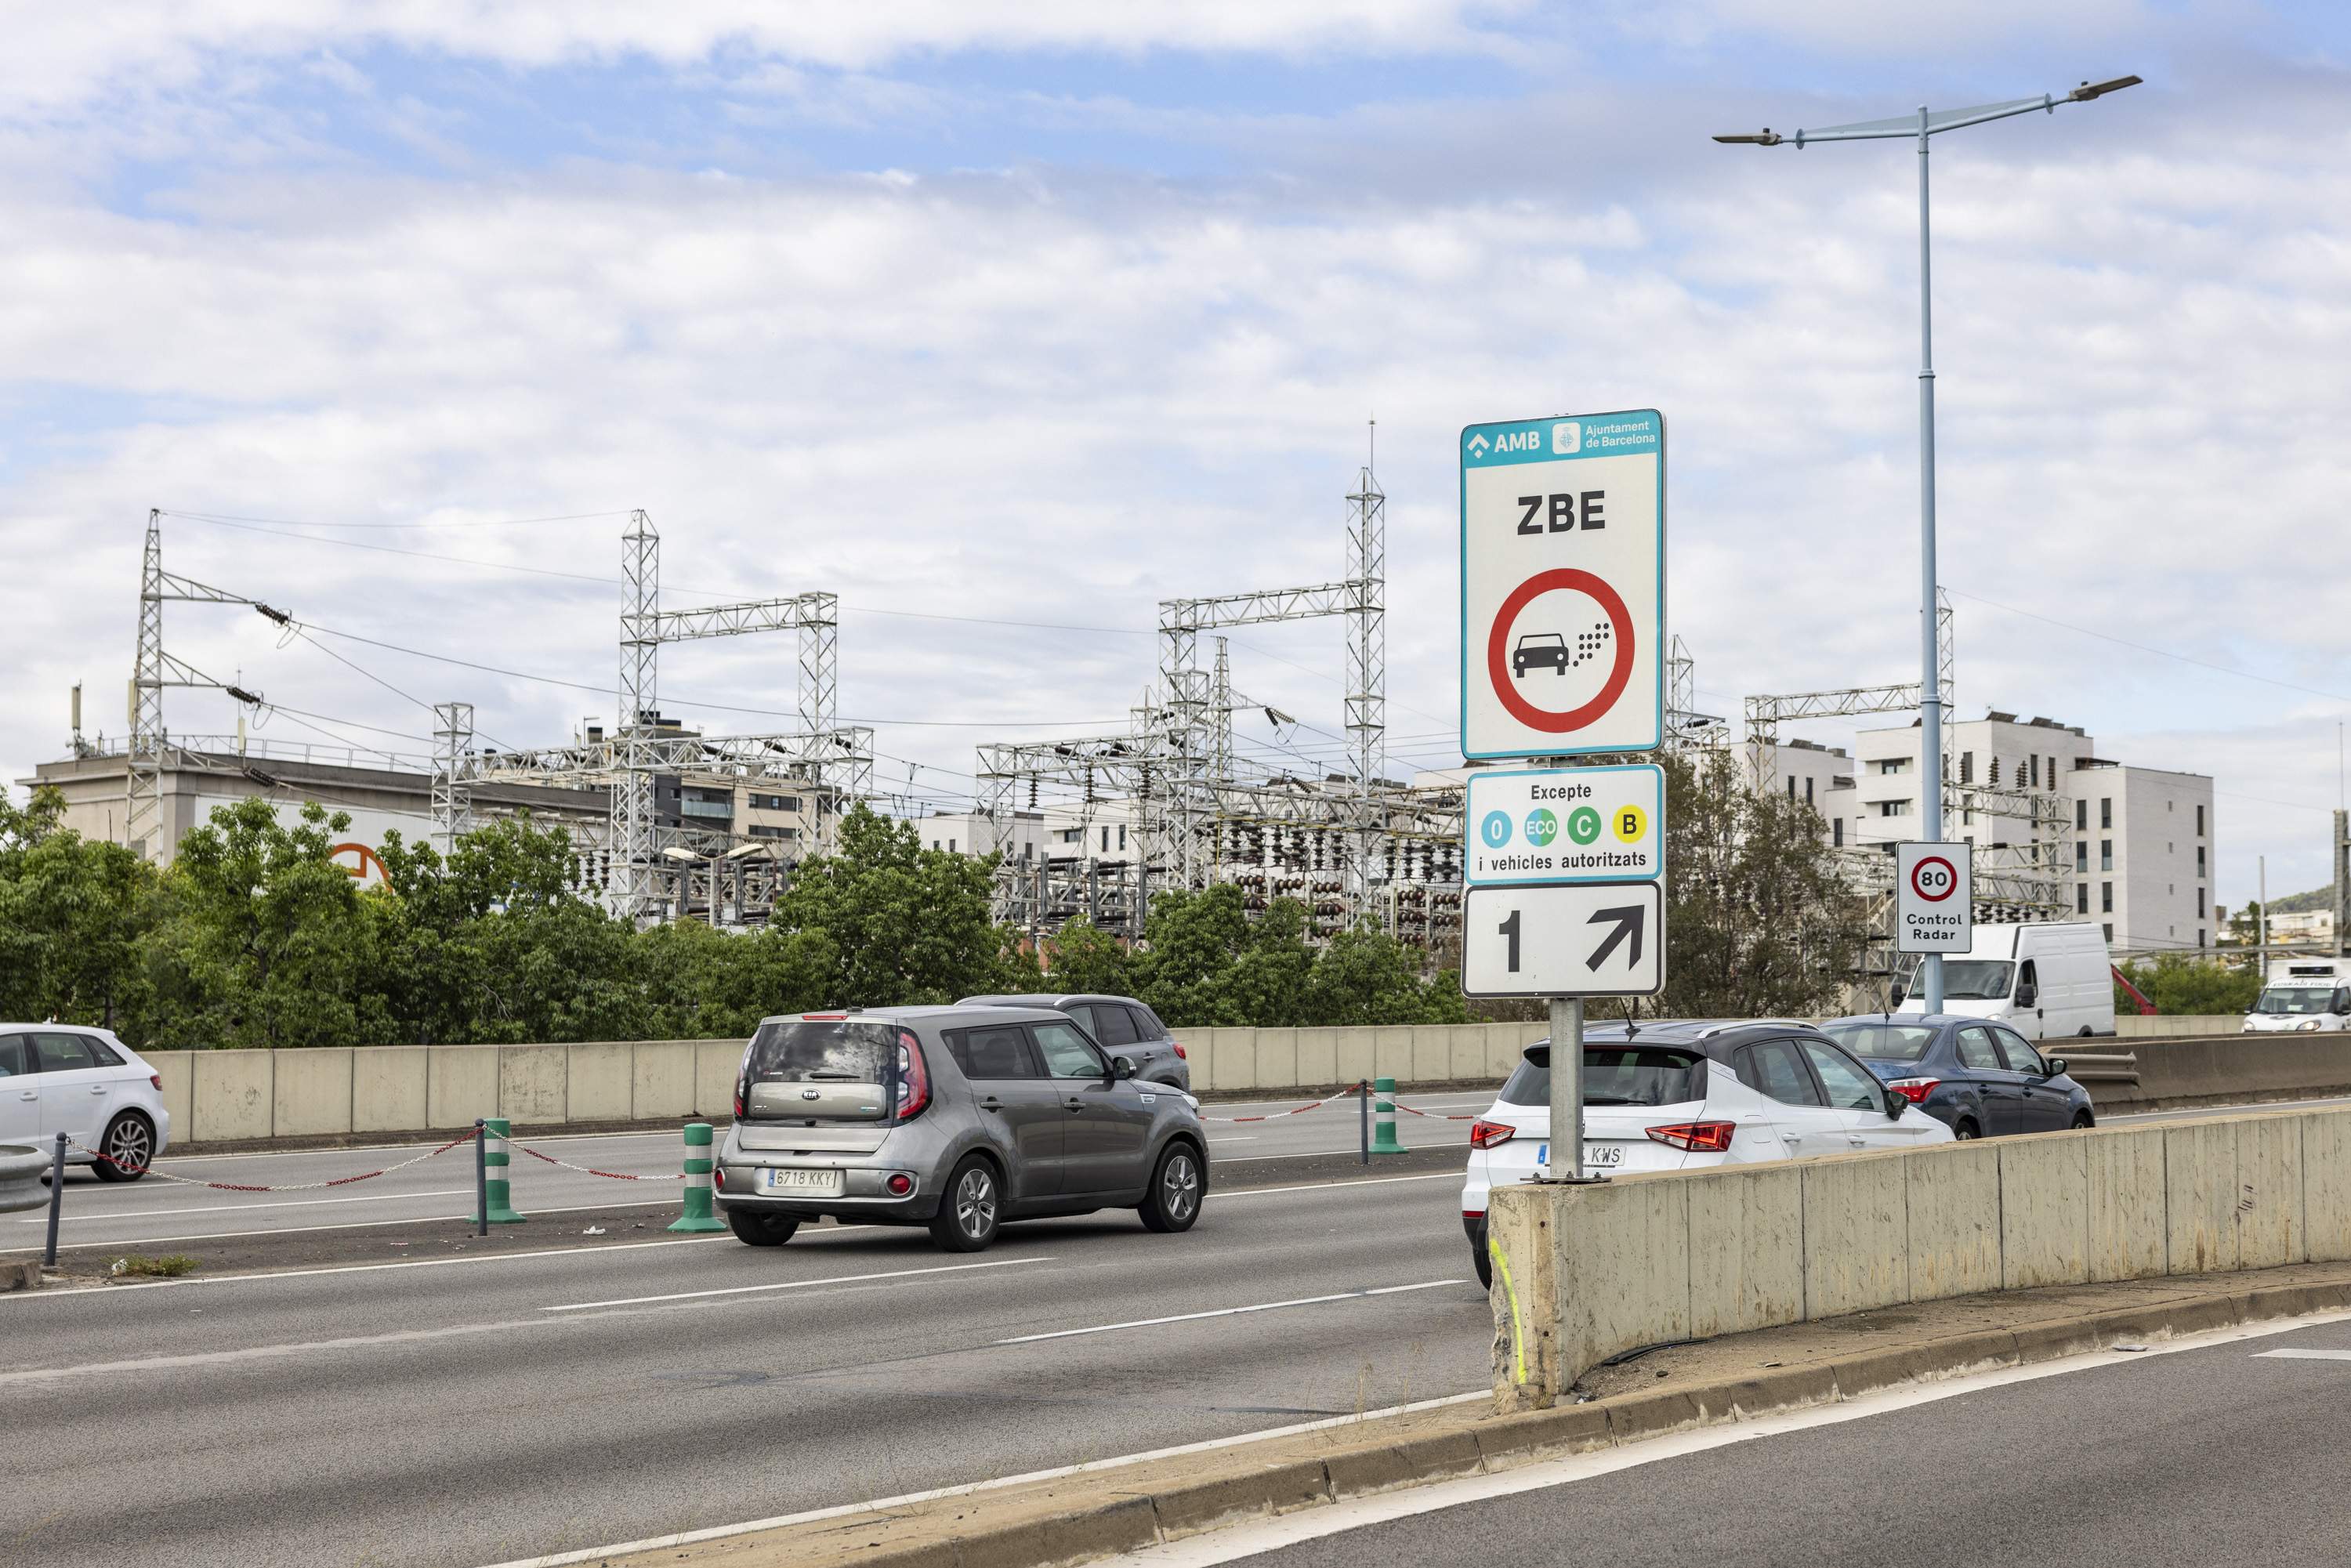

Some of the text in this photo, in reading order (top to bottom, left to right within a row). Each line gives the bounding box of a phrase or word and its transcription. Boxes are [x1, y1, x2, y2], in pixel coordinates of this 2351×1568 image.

[1585, 421, 1650, 438] Ajuntament
[1494, 431, 1541, 452] AMB
[1585, 434, 1656, 448] de Barcelona
[1517, 490, 1606, 535] ZBE
[1531, 784, 1592, 802] Excepte
[1491, 813, 1637, 840] 0 ECO C B
[1479, 852, 1646, 871] i vehicles autoritzats
[1922, 871, 1947, 886] 80
[1907, 913, 1962, 925] Control
[1498, 910, 1520, 972] 1
[1913, 929, 1956, 940] Radar
[1592, 1147, 1621, 1163] KWS
[777, 1171, 831, 1185] 6718 KKY
